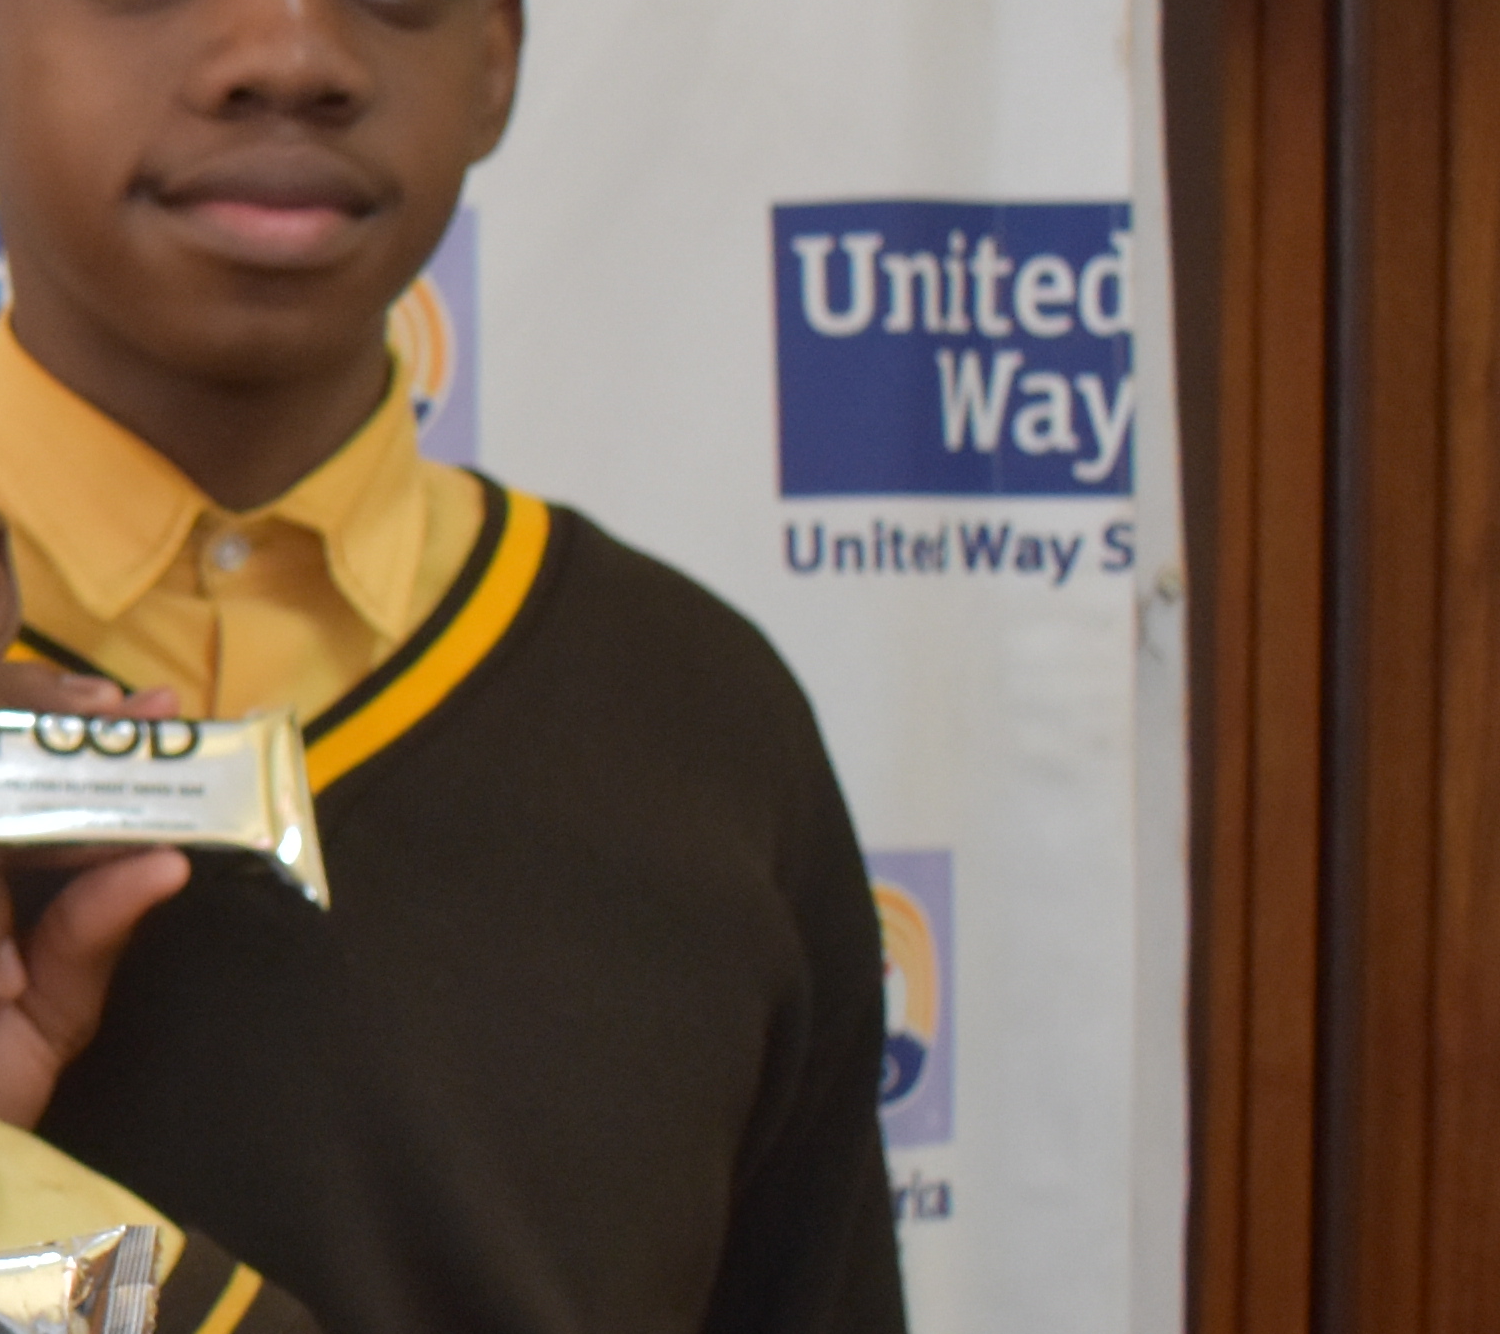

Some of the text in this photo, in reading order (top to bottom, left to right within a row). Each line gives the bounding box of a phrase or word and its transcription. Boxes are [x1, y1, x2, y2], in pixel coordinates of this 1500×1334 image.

[792, 228, 1134, 339] United
[936, 347, 1135, 483] Way
[959, 520, 1083, 589] Way
